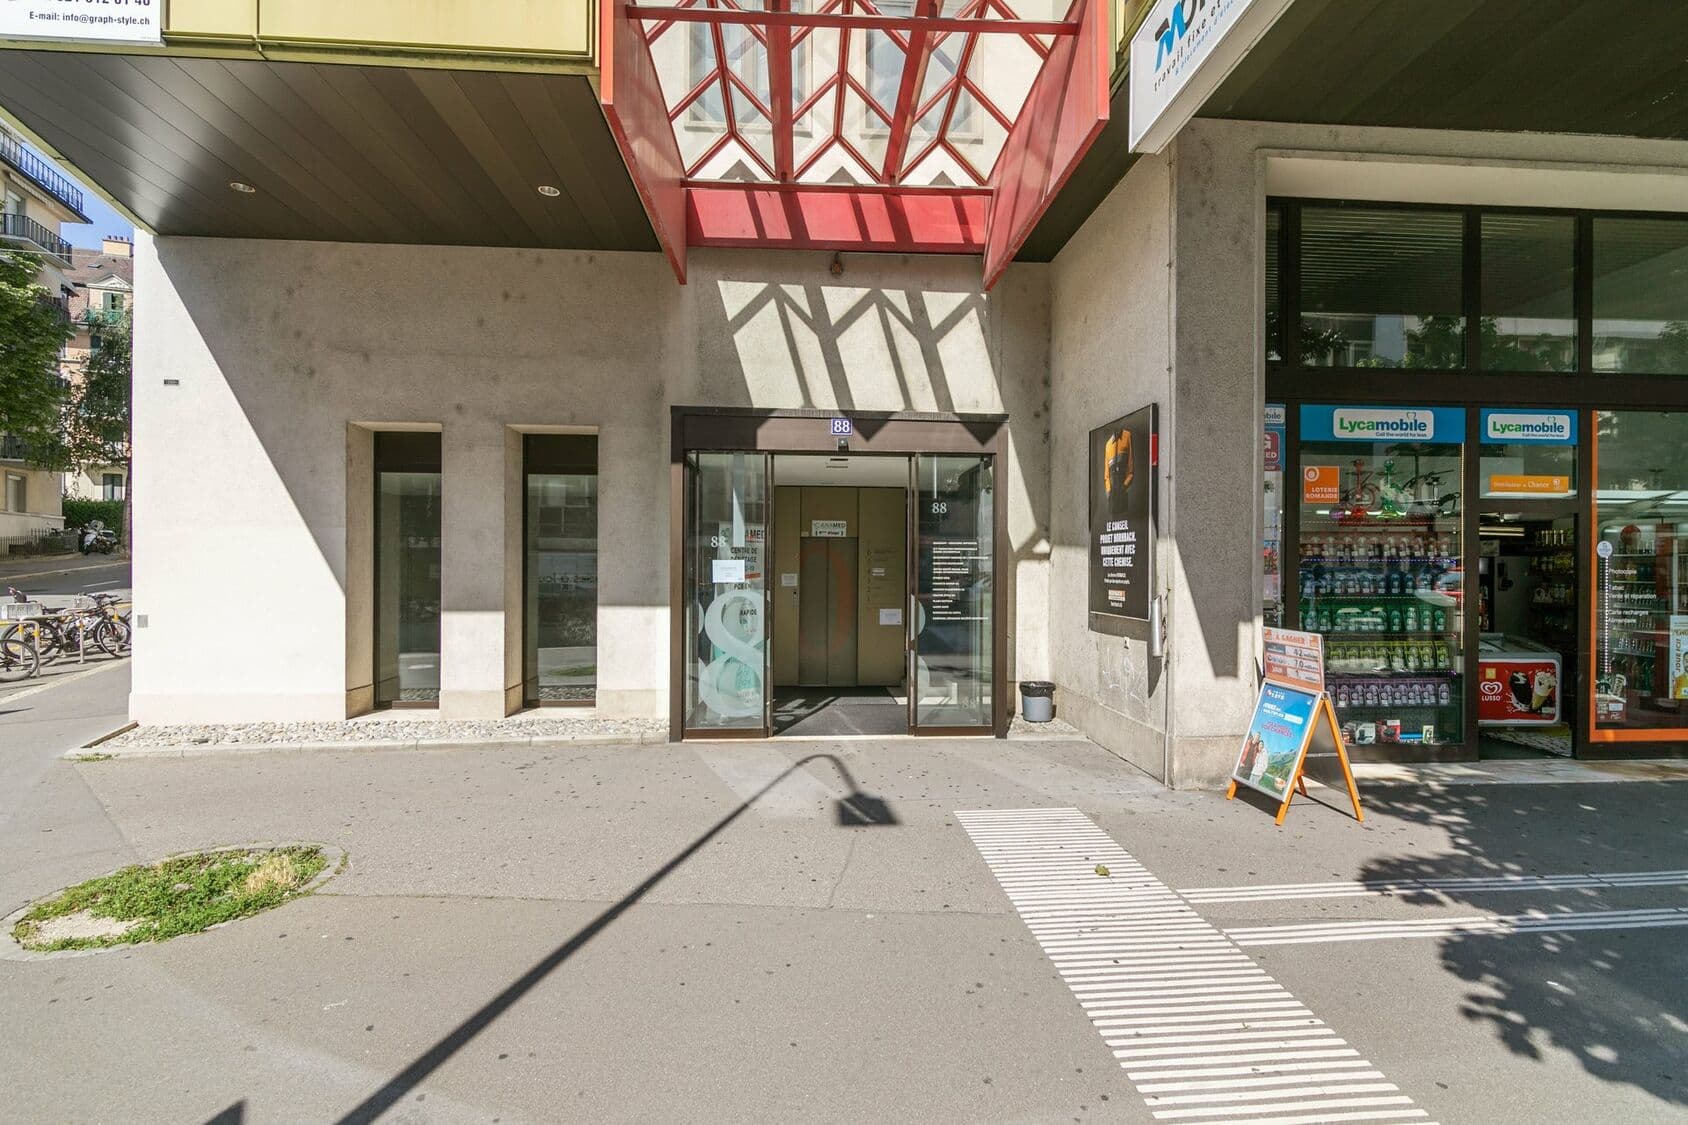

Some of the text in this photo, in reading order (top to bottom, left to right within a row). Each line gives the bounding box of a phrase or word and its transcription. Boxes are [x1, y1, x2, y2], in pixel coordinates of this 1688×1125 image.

[29, 11, 150, 26] E-mail: info@graph-style.ch
[1154, 46, 1184, 92] travail
[1187, 18, 1208, 49] fixe
[834, 420, 850, 433] 88
[1339, 417, 1428, 433] Lycamobile
[1492, 421, 1565, 434] Lycamobile
[932, 502, 947, 514] 88
[1106, 521, 1112, 532] LE
[711, 536, 727, 548] 88
[1124, 544, 1135, 554] AVEC
